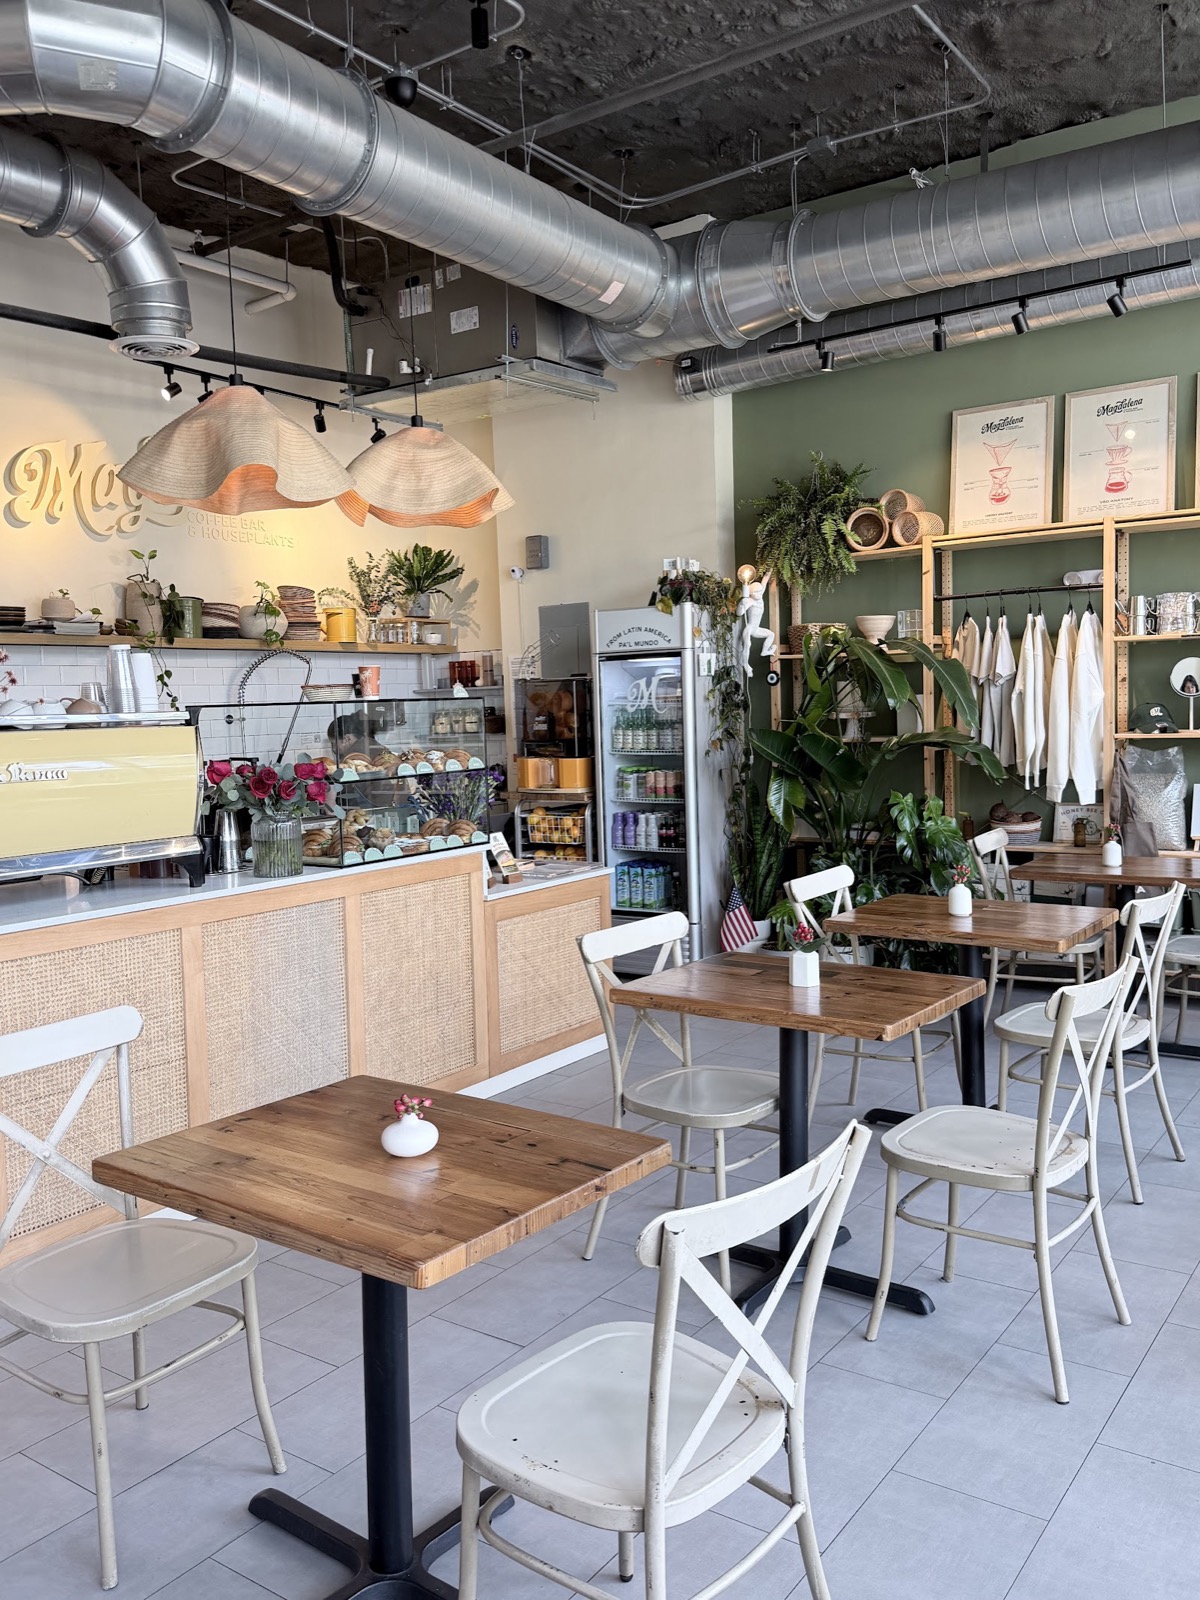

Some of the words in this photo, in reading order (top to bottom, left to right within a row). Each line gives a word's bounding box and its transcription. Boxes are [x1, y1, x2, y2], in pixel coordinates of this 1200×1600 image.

[1097, 398, 1143, 417] Magdalena
[981, 416, 1024, 434] Magdalena
[187, 510, 237, 528] COFFEE
[241, 517, 266, 532] BAR
[201, 526, 294, 548] HOUSEPLANTS
[606, 632, 622, 648] FROM
[623, 626, 642, 635] LATIN
[644, 627, 671, 644] AMERICA
